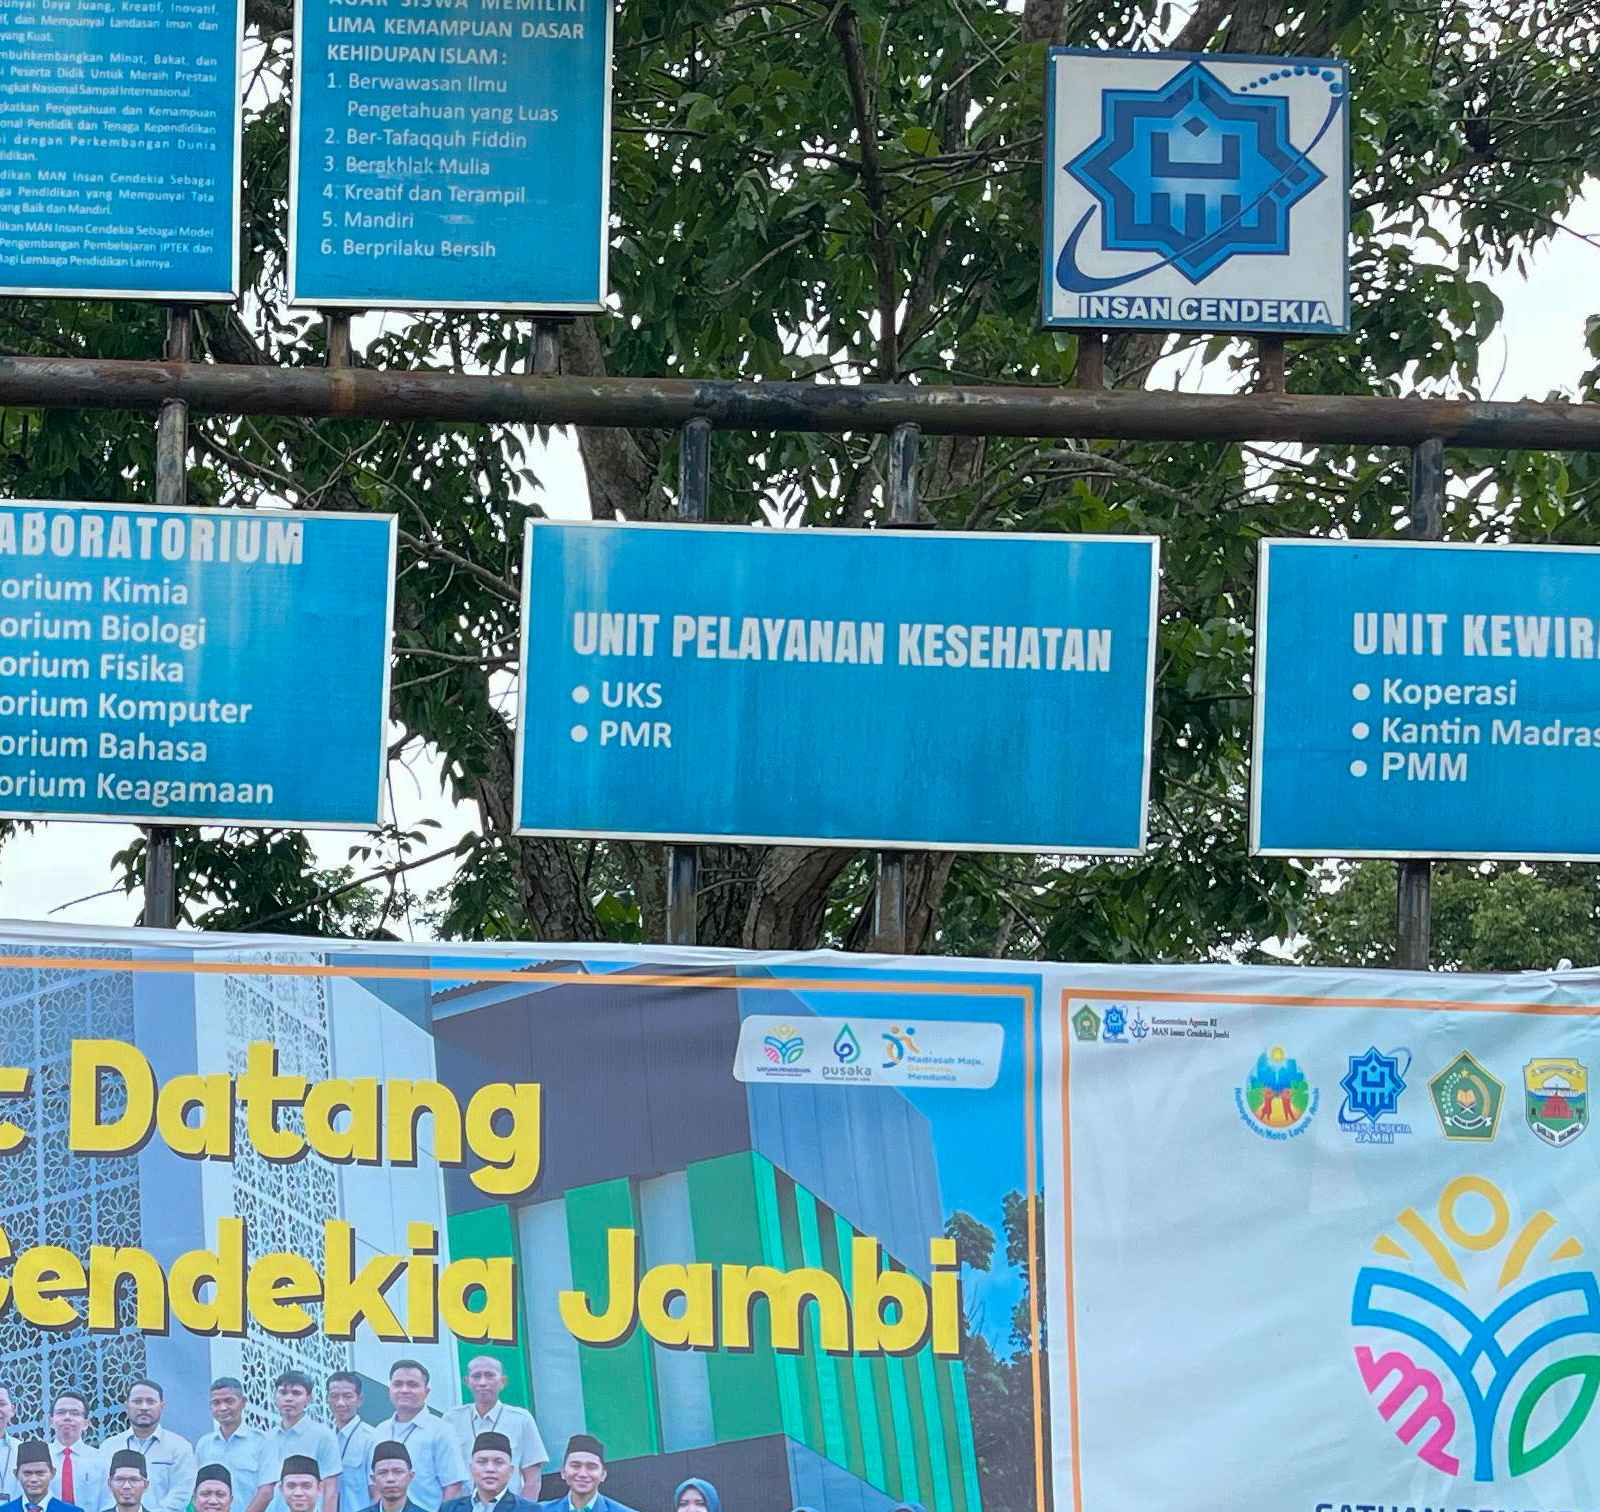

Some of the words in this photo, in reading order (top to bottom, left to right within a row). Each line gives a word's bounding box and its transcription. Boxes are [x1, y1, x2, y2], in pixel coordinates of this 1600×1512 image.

[328, 17, 375, 32] LIMA
[385, 19, 512, 37] KEMAMPUAN
[522, 22, 584, 38] DASAR
[328, 44, 435, 62] KEHIDUPAN
[349, 73, 464, 91] Berwawasan
[468, 76, 506, 92] Ilmu
[348, 101, 466, 121] Pengetahuan
[470, 108, 512, 124] yang
[518, 105, 558, 121] Luas
[347, 128, 466, 150] Ber-Tafaqquh
[472, 131, 526, 148] Fiddin
[38, 171, 67, 181] MAN
[346, 157, 432, 176] Berakhlak
[440, 160, 490, 175] Mulia
[345, 185, 403, 201] Kreatif
[409, 185, 441, 202] dan
[449, 186, 525, 206] Terampil
[345, 212, 413, 228] Mandiri
[343, 239, 434, 258] Berprilaku
[441, 241, 495, 256] Bersih
[1078, 297, 1171, 320] INSAN
[1178, 298, 1332, 324] CENDEKIA
[103, 577, 191, 605] Kimia
[102, 611, 206, 652] Biologi
[573, 611, 659, 656] UNIT
[673, 615, 884, 664] PELAYANAN
[899, 624, 1111, 672] KESEHATAN
[1354, 613, 1447, 655] UNIT
[1464, 615, 1600, 658] KEWIR
[101, 654, 184, 682] Fisika
[602, 681, 662, 708] UKS
[1384, 678, 1516, 710] Koperasi
[99, 693, 252, 727] Komputer
[601, 720, 671, 748] PMR
[1383, 718, 1480, 744] Kantin
[99, 733, 207, 761] Bahasa
[1383, 752, 1467, 781] PMM
[97, 773, 273, 807] Keagamaan
[822, 1065, 871, 1079] pusaka
[69, 1038, 542, 1196] Datang
[559, 1227, 963, 1356] Jambi
